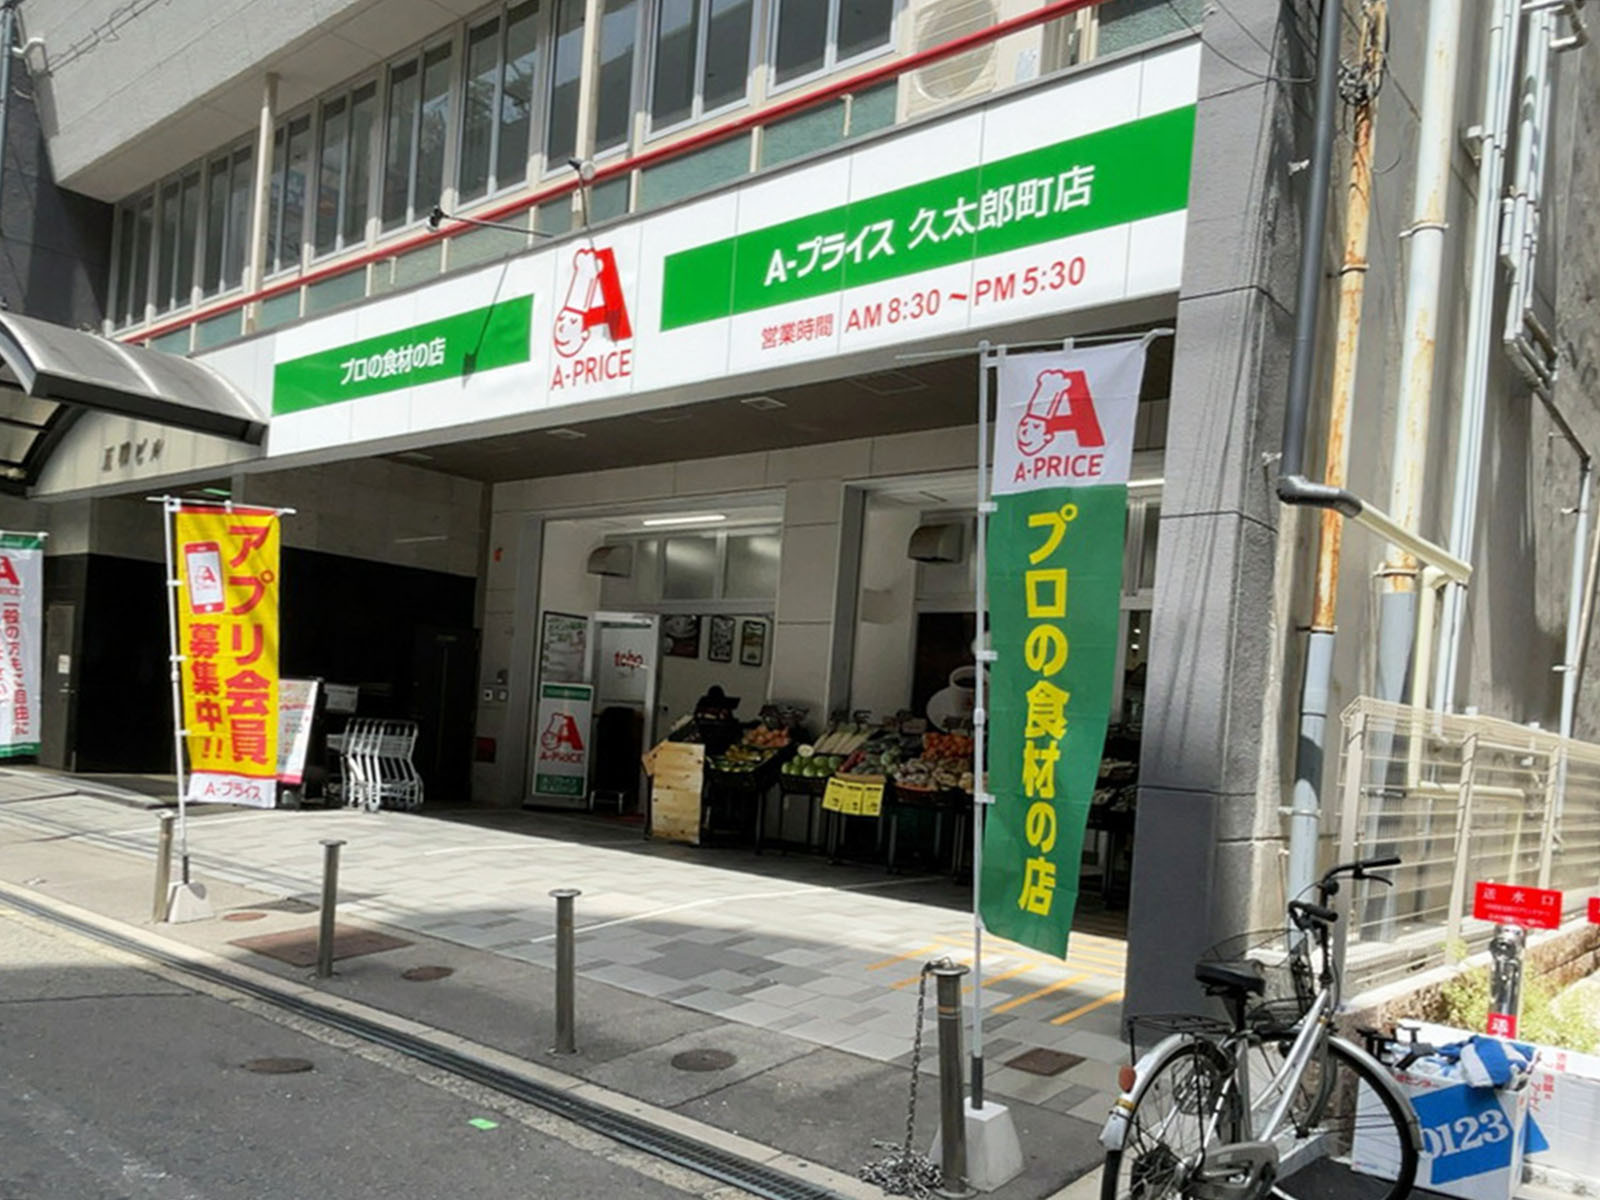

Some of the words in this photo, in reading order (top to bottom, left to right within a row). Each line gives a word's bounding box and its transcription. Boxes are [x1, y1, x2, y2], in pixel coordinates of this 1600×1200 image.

[763, 218, 896, 287] A-プライス
[907, 164, 1096, 250] 久太郎町店
[760, 312, 835, 351] 営業時間
[844, 303, 883, 333] AM
[886, 288, 941, 325] 8:30
[973, 273, 1017, 307] PM
[1021, 255, 1087, 297] 5:30
[339, 337, 447, 386] プロの食材の店
[549, 348, 633, 392] A-PRICE
[1013, 453, 1105, 484] A-PRICE
[225, 525, 274, 765] アプリ会員
[1016, 502, 1079, 916] プロの食材の店
